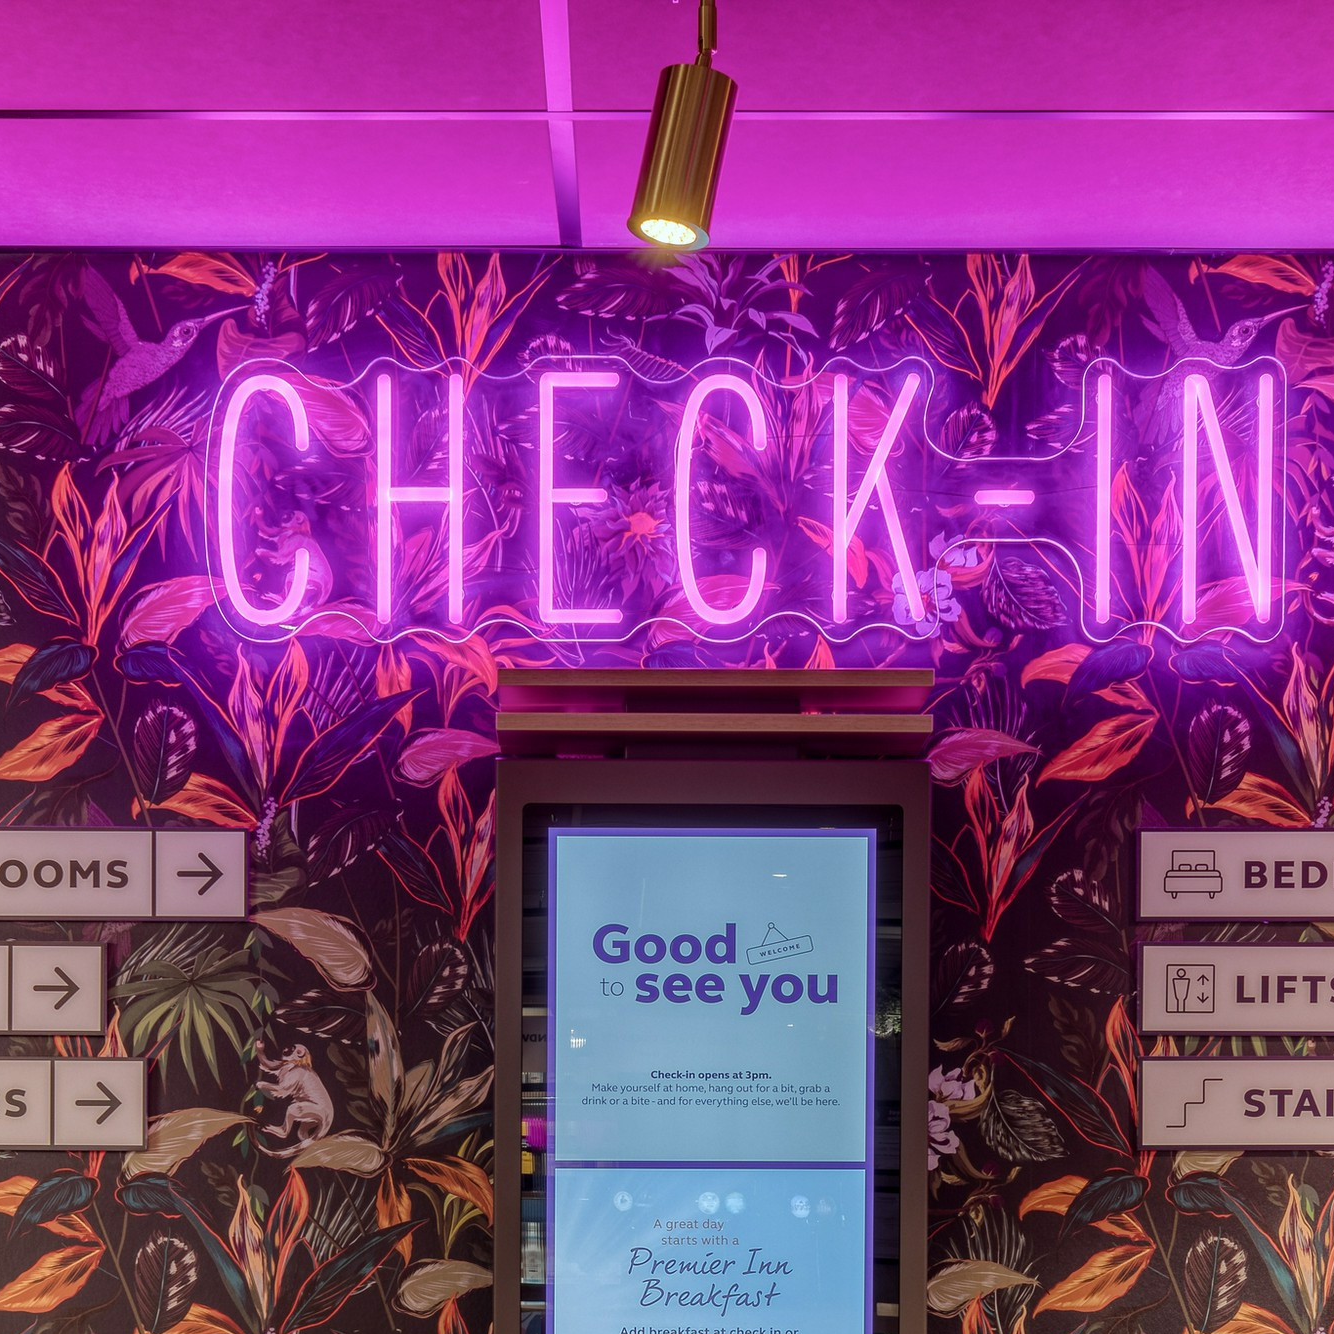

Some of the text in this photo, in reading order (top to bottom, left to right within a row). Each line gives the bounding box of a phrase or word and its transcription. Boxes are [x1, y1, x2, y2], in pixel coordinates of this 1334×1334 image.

[218, 372, 1273, 624] CHECK-IN
[593, 923, 736, 964] Good
[759, 944, 800, 957] WELCOME
[600, 973, 838, 1015] to see you
[651, 1070, 771, 1081] Check-in opens at 3pm.
[592, 1083, 618, 1092] Make
[620, 1083, 661, 1095] yourself
[663, 1083, 674, 1092] at
[676, 1083, 706, 1094] home,
[709, 1083, 733, 1095] hang
[736, 1083, 753, 1092] out
[756, 1083, 770, 1092] for
[781, 1083, 797, 1094] bit,
[799, 1083, 823, 1095] grab
[581, 1096, 607, 1105] drink
[630, 1096, 650, 1105] bite
[657, 1096, 678, 1105] and
[678, 1096, 693, 1105] for
[695, 1096, 748, 1108] everything
[751, 1096, 773, 1107] else,
[775, 1097, 800, 1106] we'll
[800, 1097, 813, 1106] be
[816, 1097, 840, 1106] here.
[654, 1219, 724, 1231] A great day
[661, 1236, 697, 1245] starts
[701, 1235, 728, 1245] with
[629, 1248, 793, 1274] Premier Inn
[640, 1279, 781, 1317] Breakfast
